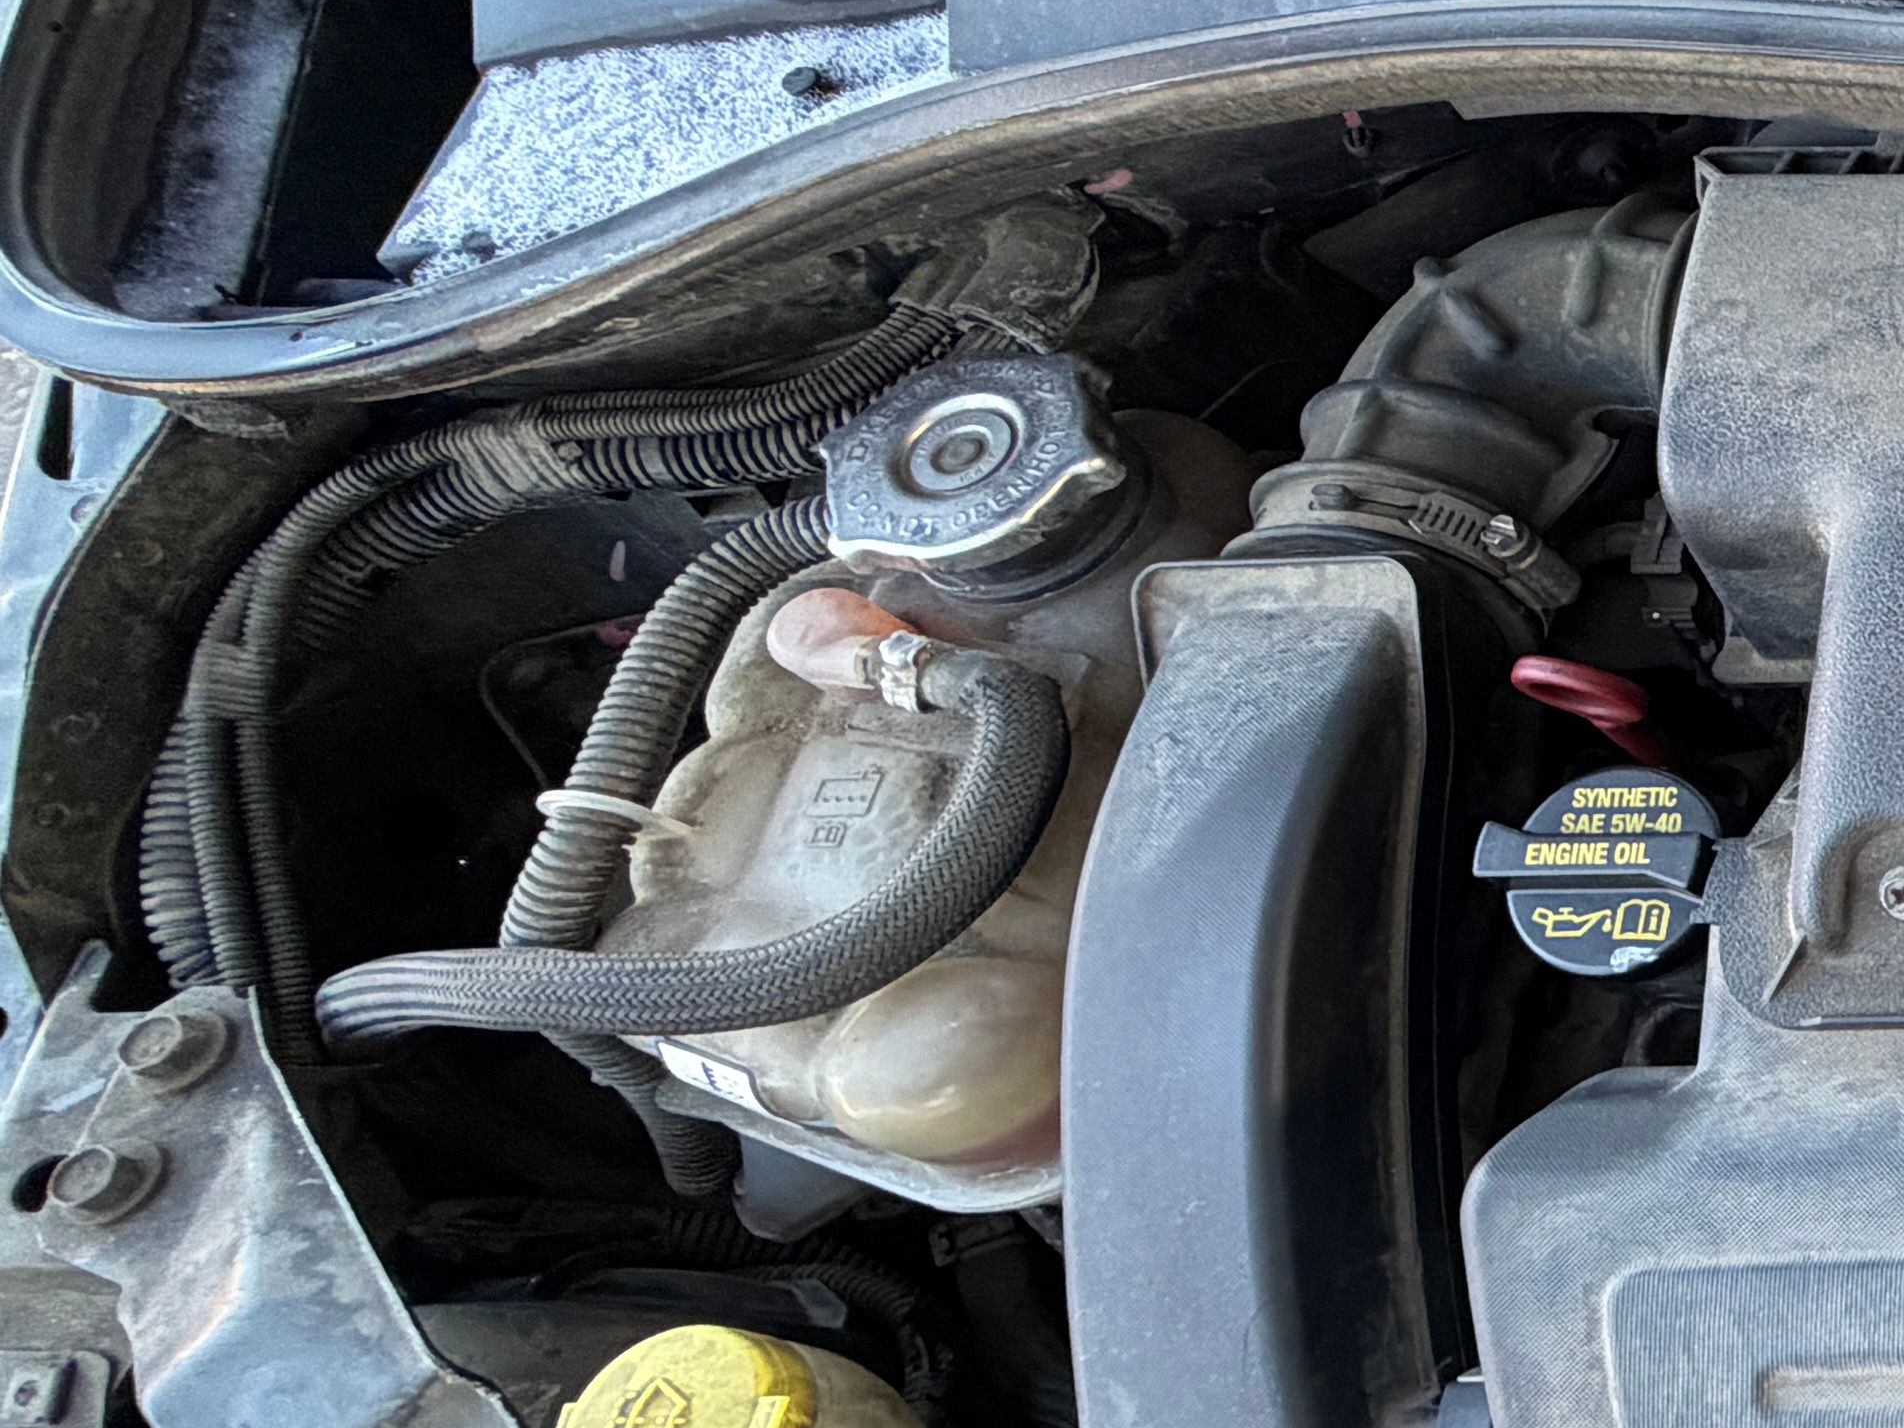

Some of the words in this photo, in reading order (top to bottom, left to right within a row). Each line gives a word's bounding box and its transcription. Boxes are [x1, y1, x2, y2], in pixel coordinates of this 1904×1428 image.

[1571, 787, 1678, 809] SYNTHETIC
[1560, 814, 1605, 835] SAE
[1610, 813, 1683, 834] 5W-40
[1524, 843, 1608, 866] ENGINE
[1614, 843, 1651, 865] OIL
